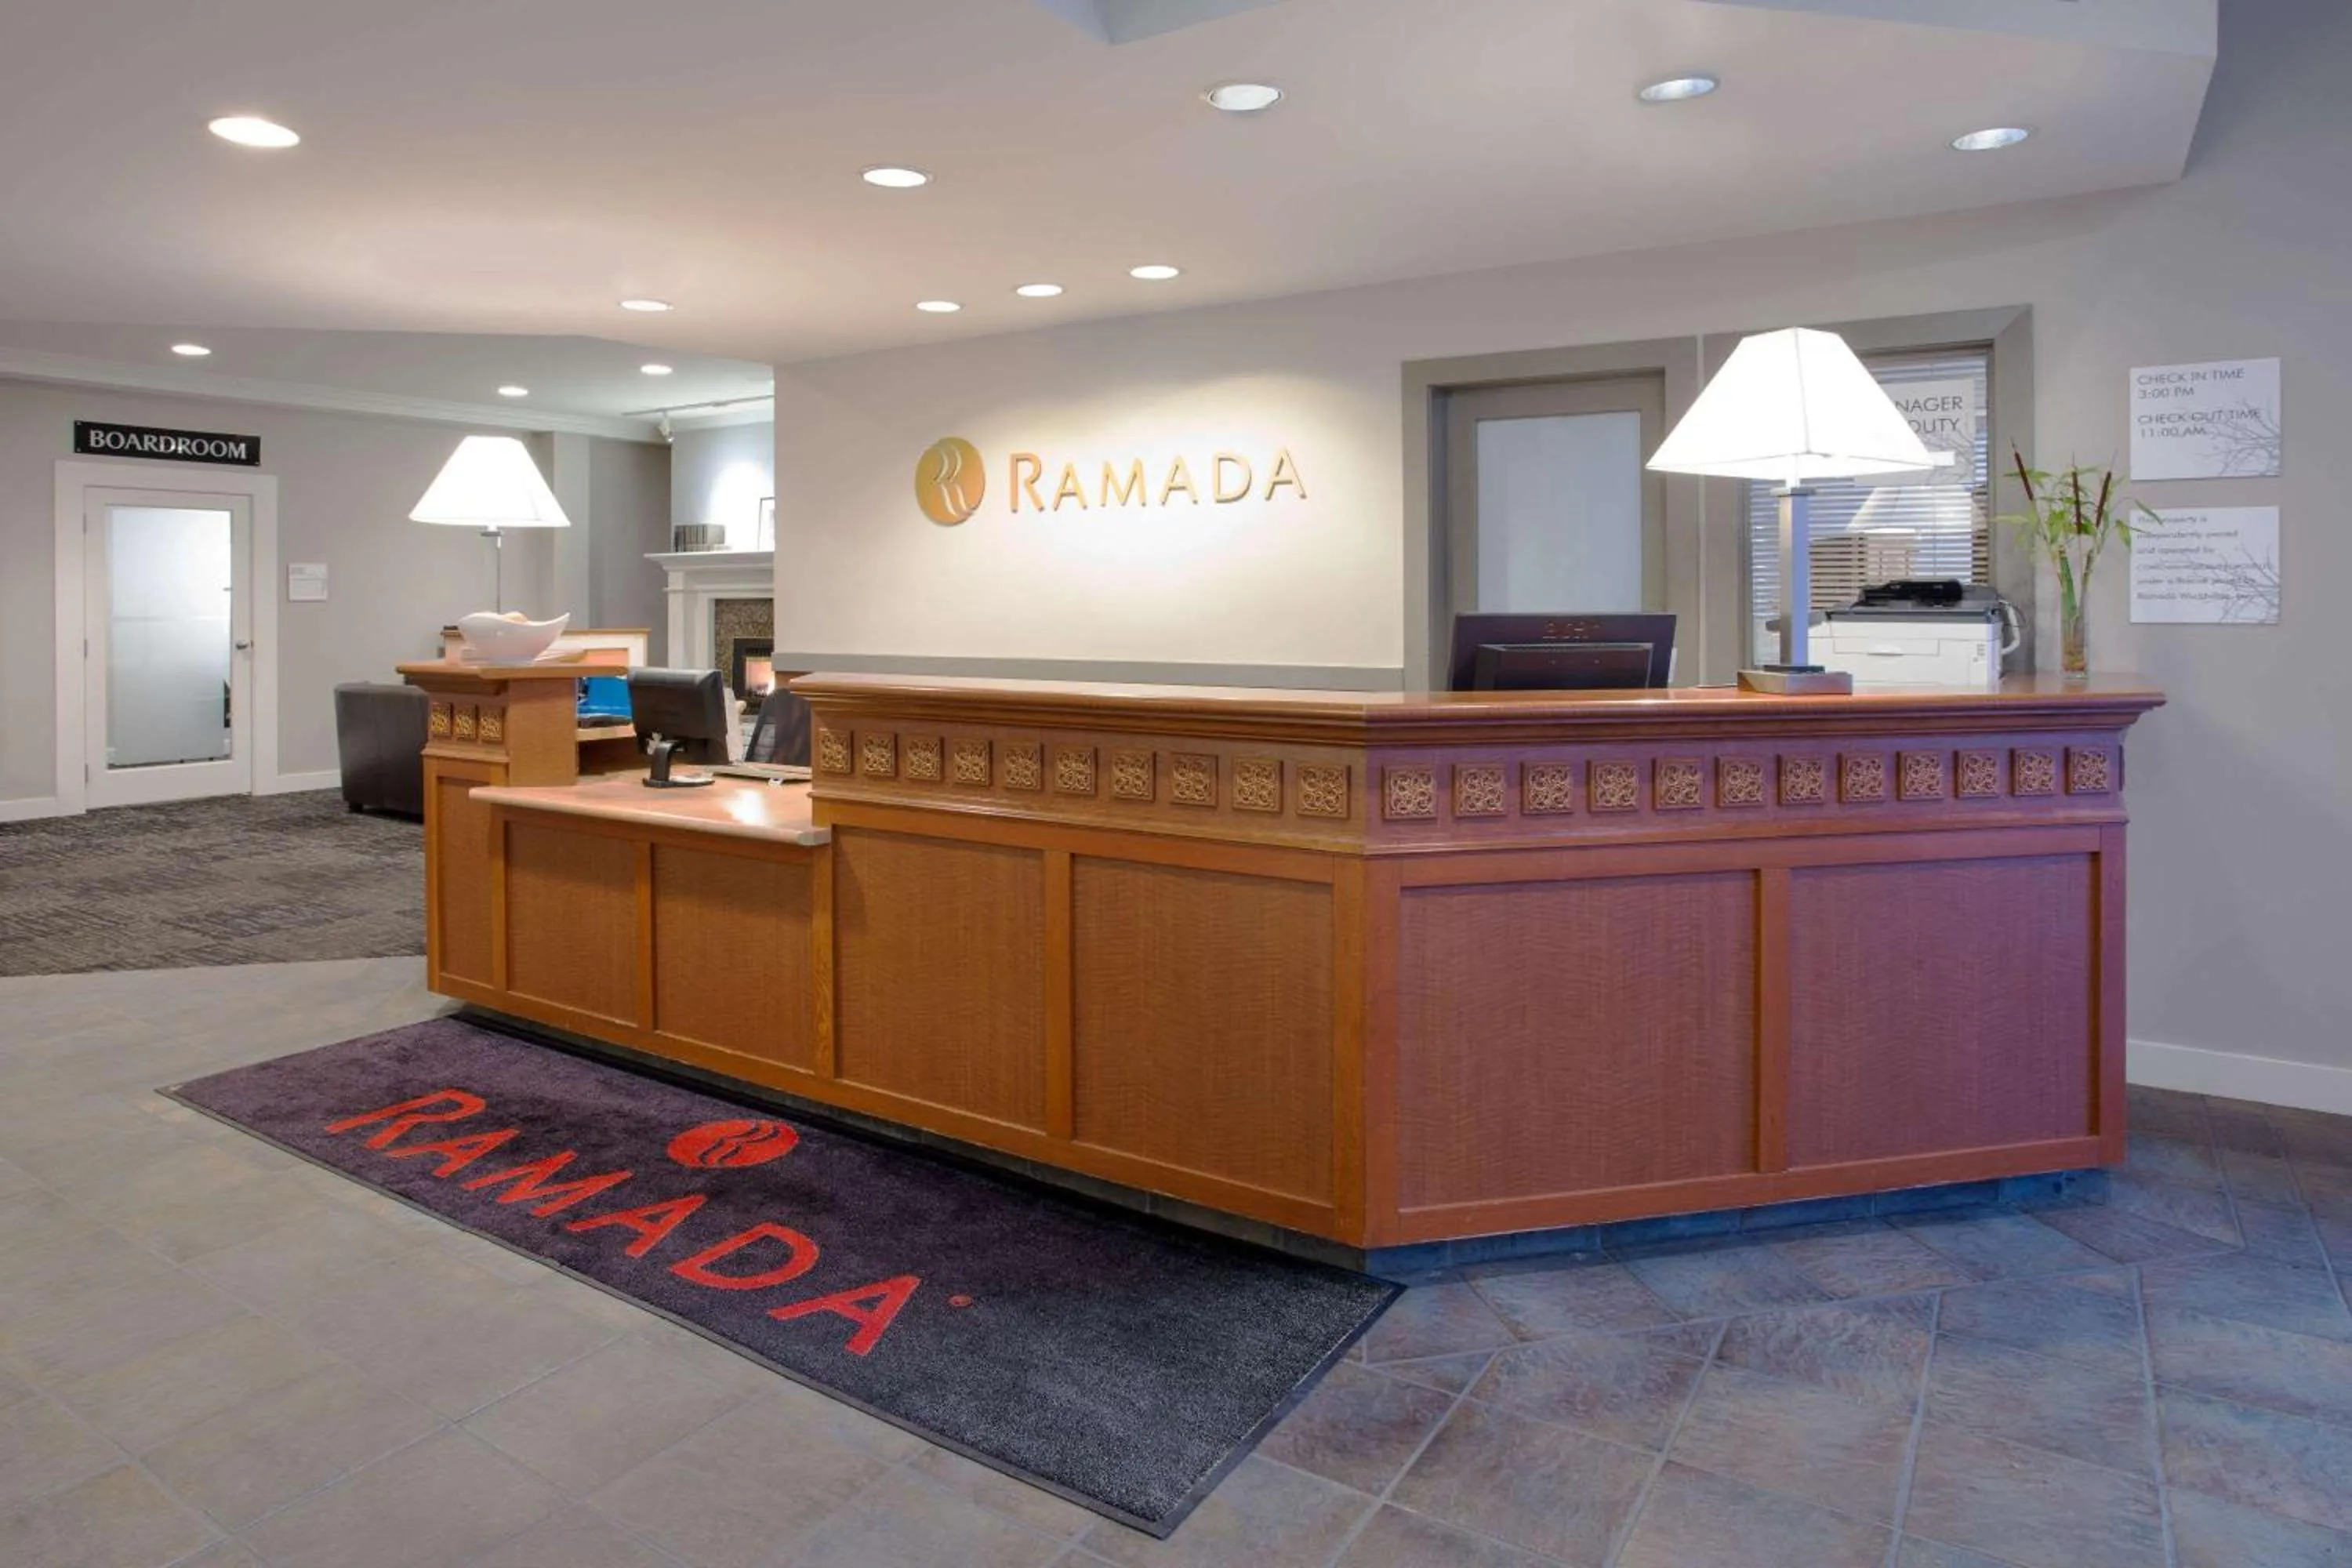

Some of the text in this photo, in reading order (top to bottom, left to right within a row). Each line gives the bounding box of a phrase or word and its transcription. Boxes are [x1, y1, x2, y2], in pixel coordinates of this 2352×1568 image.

[2136, 367, 2245, 386] CHECK IN TIME
[2137, 386, 2194, 399] 3:00 PM
[1895, 395, 1963, 412] NAGER
[2137, 412, 2187, 425] CHECK
[2228, 408, 2261, 420] TIME
[2140, 426, 2207, 439] 11:00 AM
[89, 429, 247, 460] BOARDROOM
[1008, 448, 1307, 514] RAMADA
[326, 1087, 920, 1356] RAMADA
